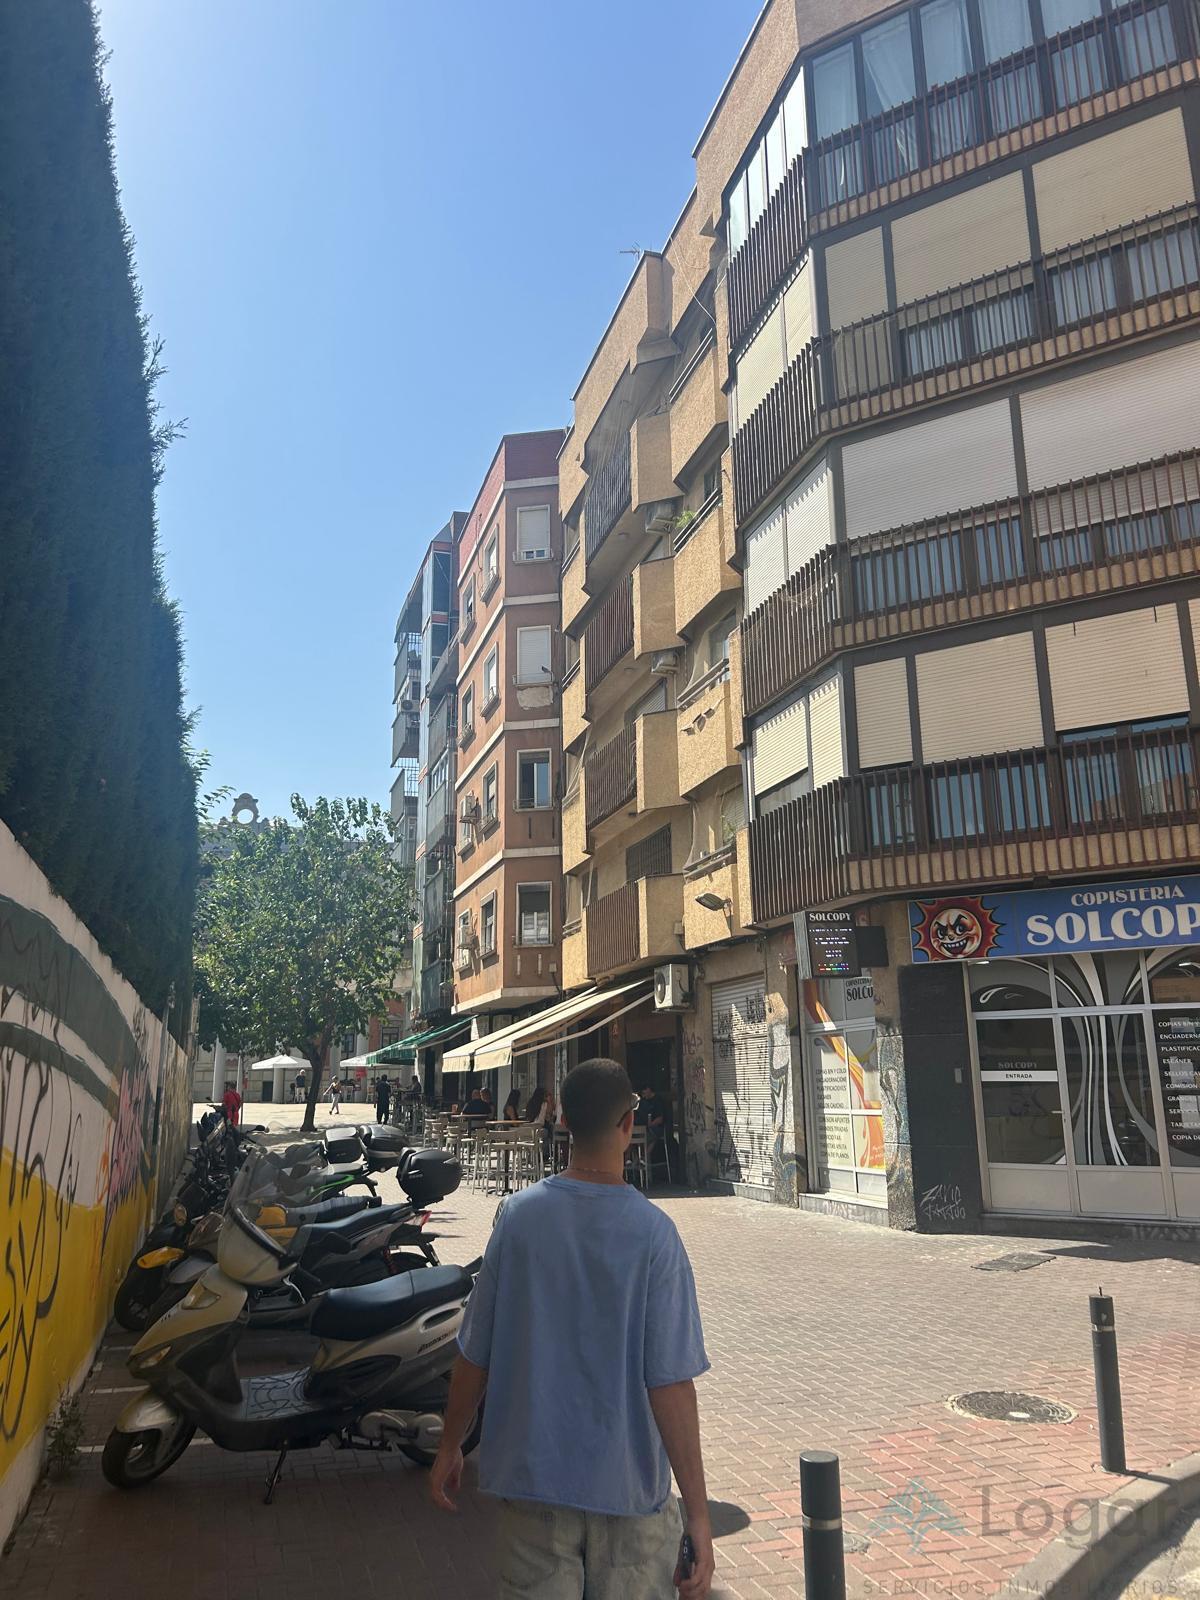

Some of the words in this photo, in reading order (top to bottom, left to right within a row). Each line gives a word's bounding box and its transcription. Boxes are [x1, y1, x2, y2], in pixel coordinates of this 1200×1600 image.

[1071, 885, 1184, 906] COPISTERIA
[809, 912, 851, 921] SOLCOPY
[1027, 903, 1200, 946] SOLCOP
